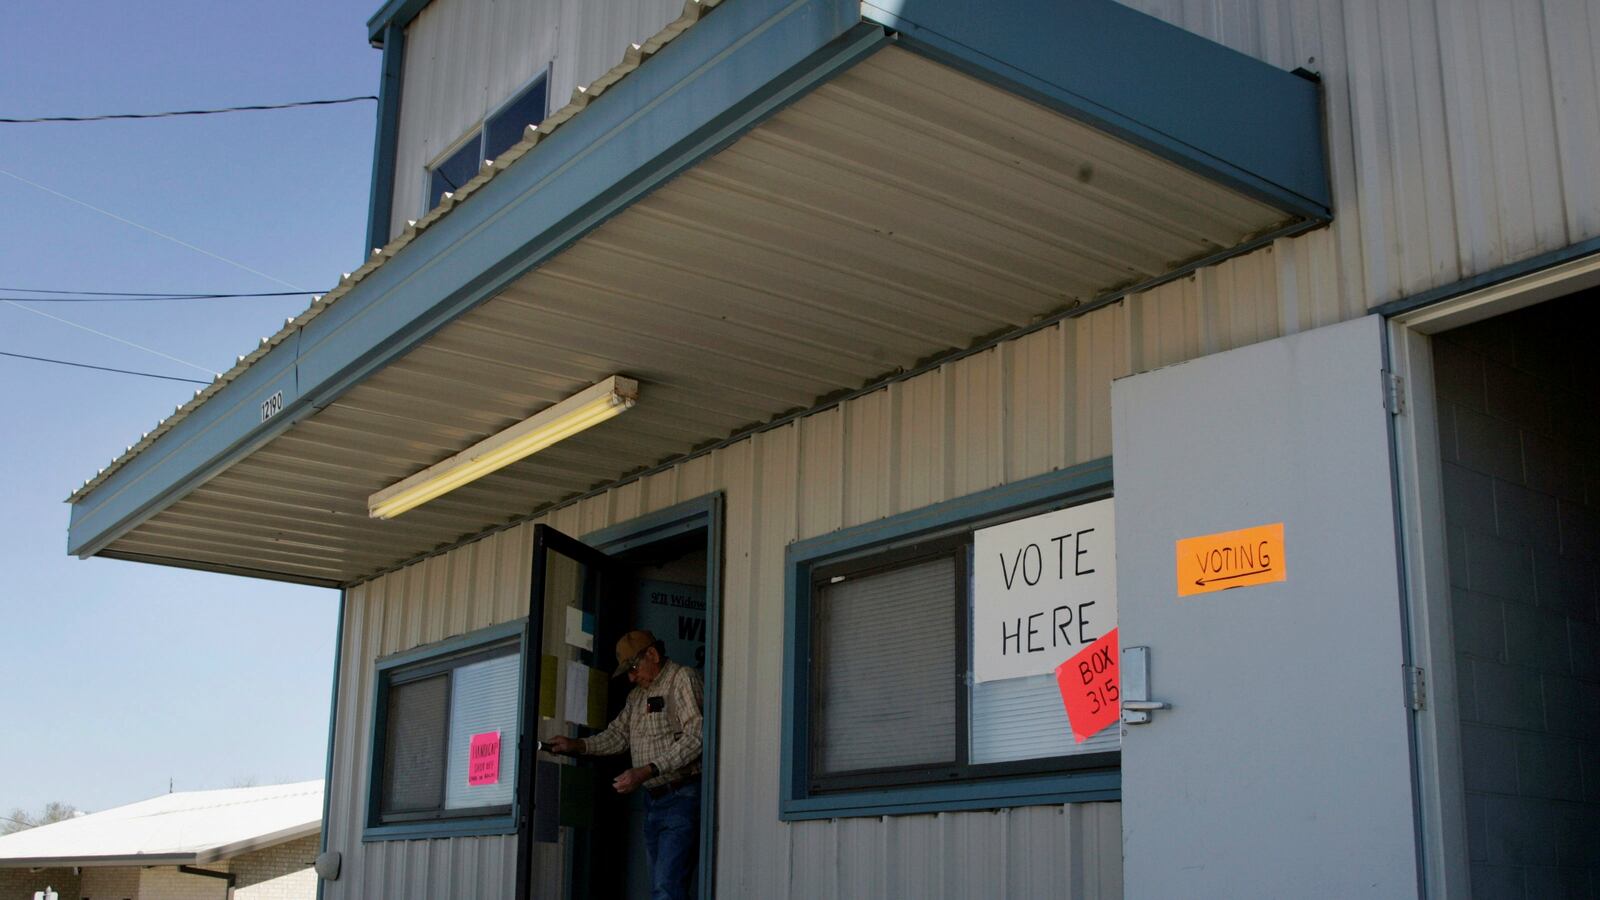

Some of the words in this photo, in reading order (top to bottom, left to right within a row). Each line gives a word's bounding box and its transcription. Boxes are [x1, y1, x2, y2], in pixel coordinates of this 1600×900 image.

[261, 391, 283, 421] 12190
[1000, 528, 1096, 591] VOTE
[1196, 541, 1271, 575] VOTING
[671, 594, 706, 611] Widow
[1002, 601, 1098, 655] HERE
[1079, 645, 1114, 685] BOX
[1086, 678, 1120, 714] 315
